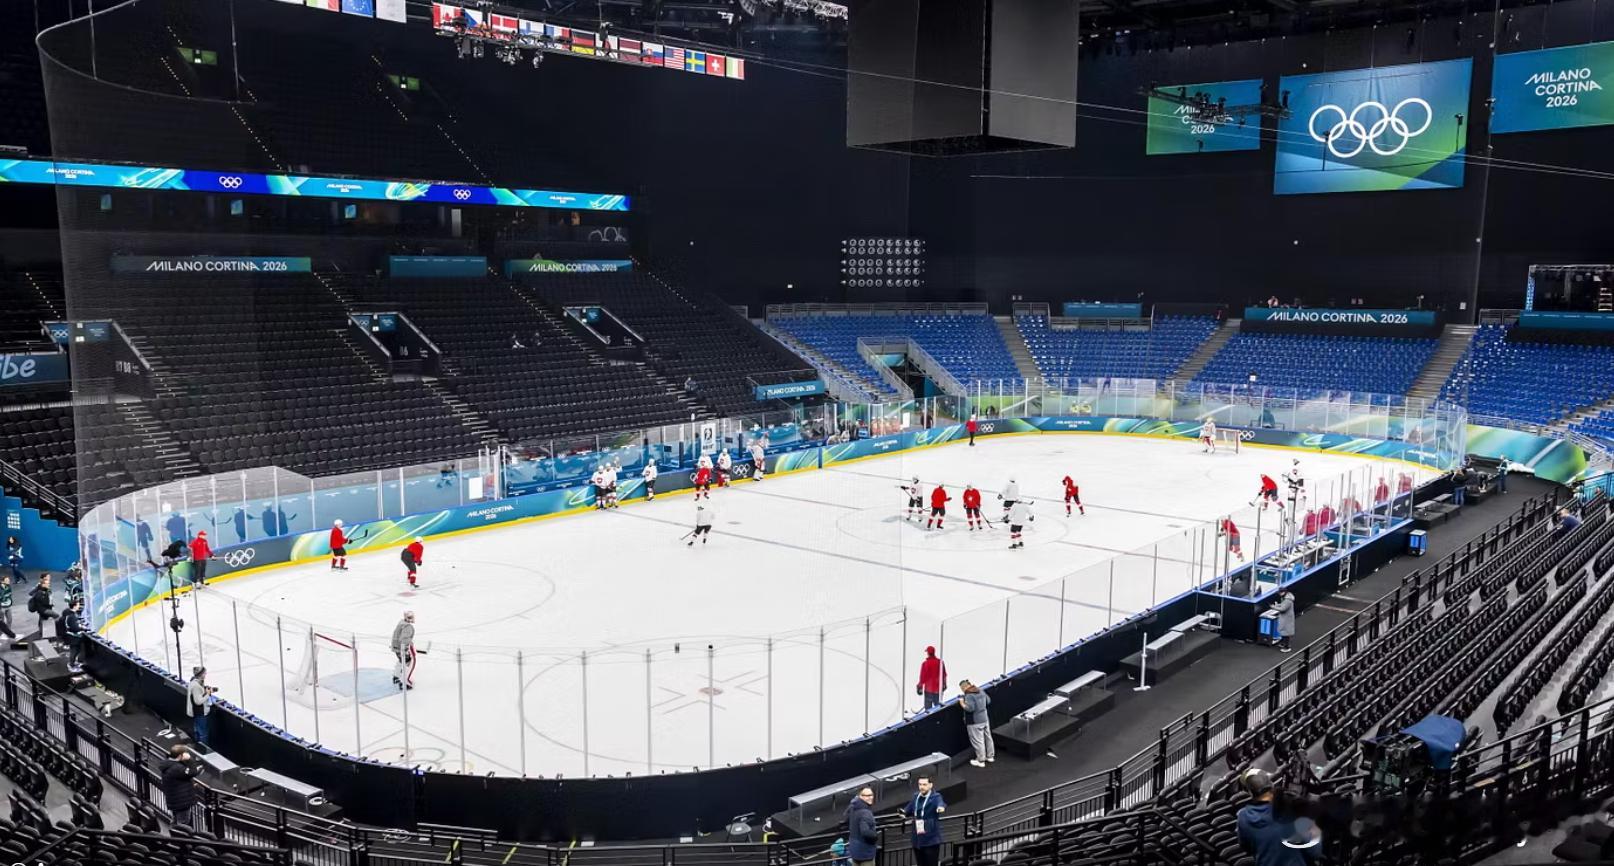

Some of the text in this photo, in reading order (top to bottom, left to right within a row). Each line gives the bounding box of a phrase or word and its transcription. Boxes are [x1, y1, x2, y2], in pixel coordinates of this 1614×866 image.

[1524, 67, 1591, 85] MILANO
[1535, 80, 1603, 96] CORTINA
[1545, 94, 1578, 108] 2026
[1191, 124, 1215, 134] 2026
[146, 261, 287, 271] MILANO CORTINA 2026
[529, 263, 565, 272] MILANO
[565, 263, 600, 272] CORTINA
[1267, 311, 1408, 324] MILANO CORTINA 2026
